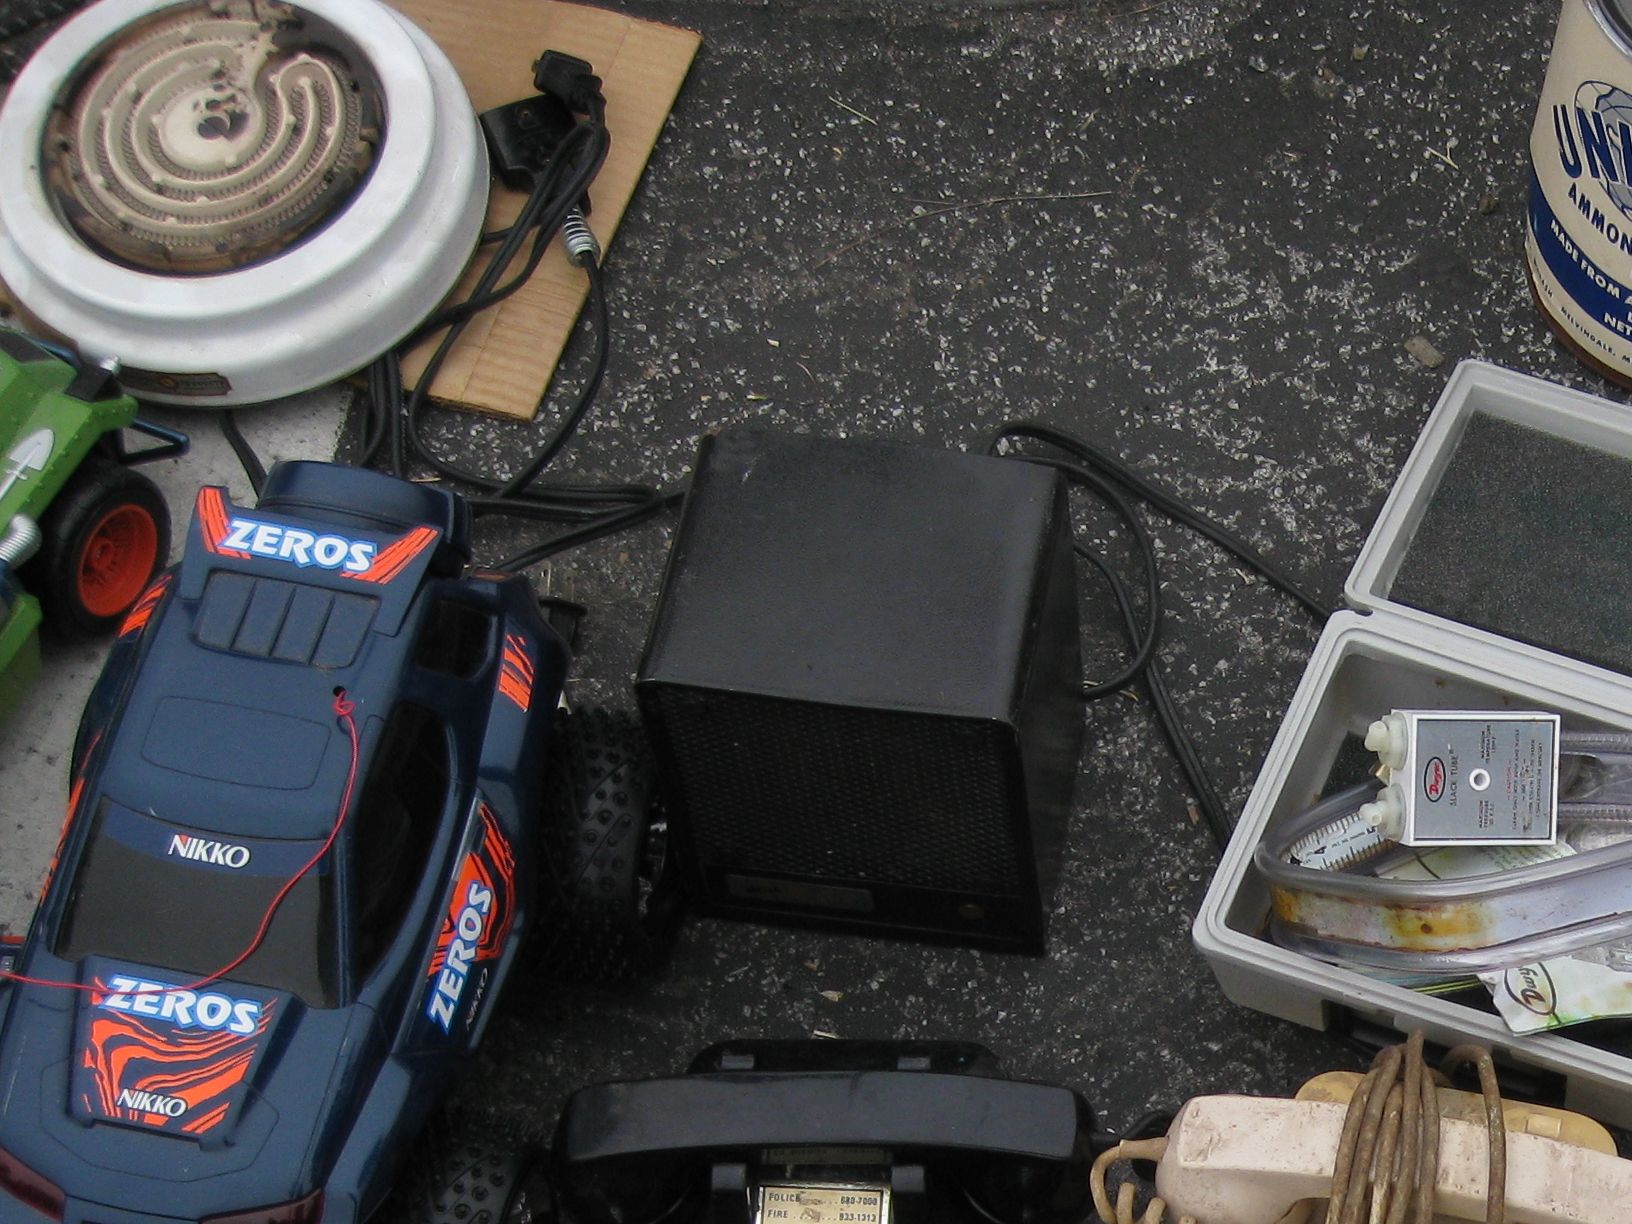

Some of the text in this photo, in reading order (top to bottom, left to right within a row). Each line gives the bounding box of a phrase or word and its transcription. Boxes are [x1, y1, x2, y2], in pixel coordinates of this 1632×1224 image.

[1550, 219, 1579, 262] MADE
[1580, 257, 1621, 299] FROM
[222, 518, 375, 573] ZEROS
[167, 833, 251, 869] NIKKO
[431, 882, 492, 1029] ZEROS
[104, 975, 260, 1034] ZEROS
[1518, 967, 1545, 1006] Dwy
[116, 1087, 188, 1118] NIKKO
[767, 1210, 789, 1219] FIRE
[768, 1192, 802, 1203] POLICE
